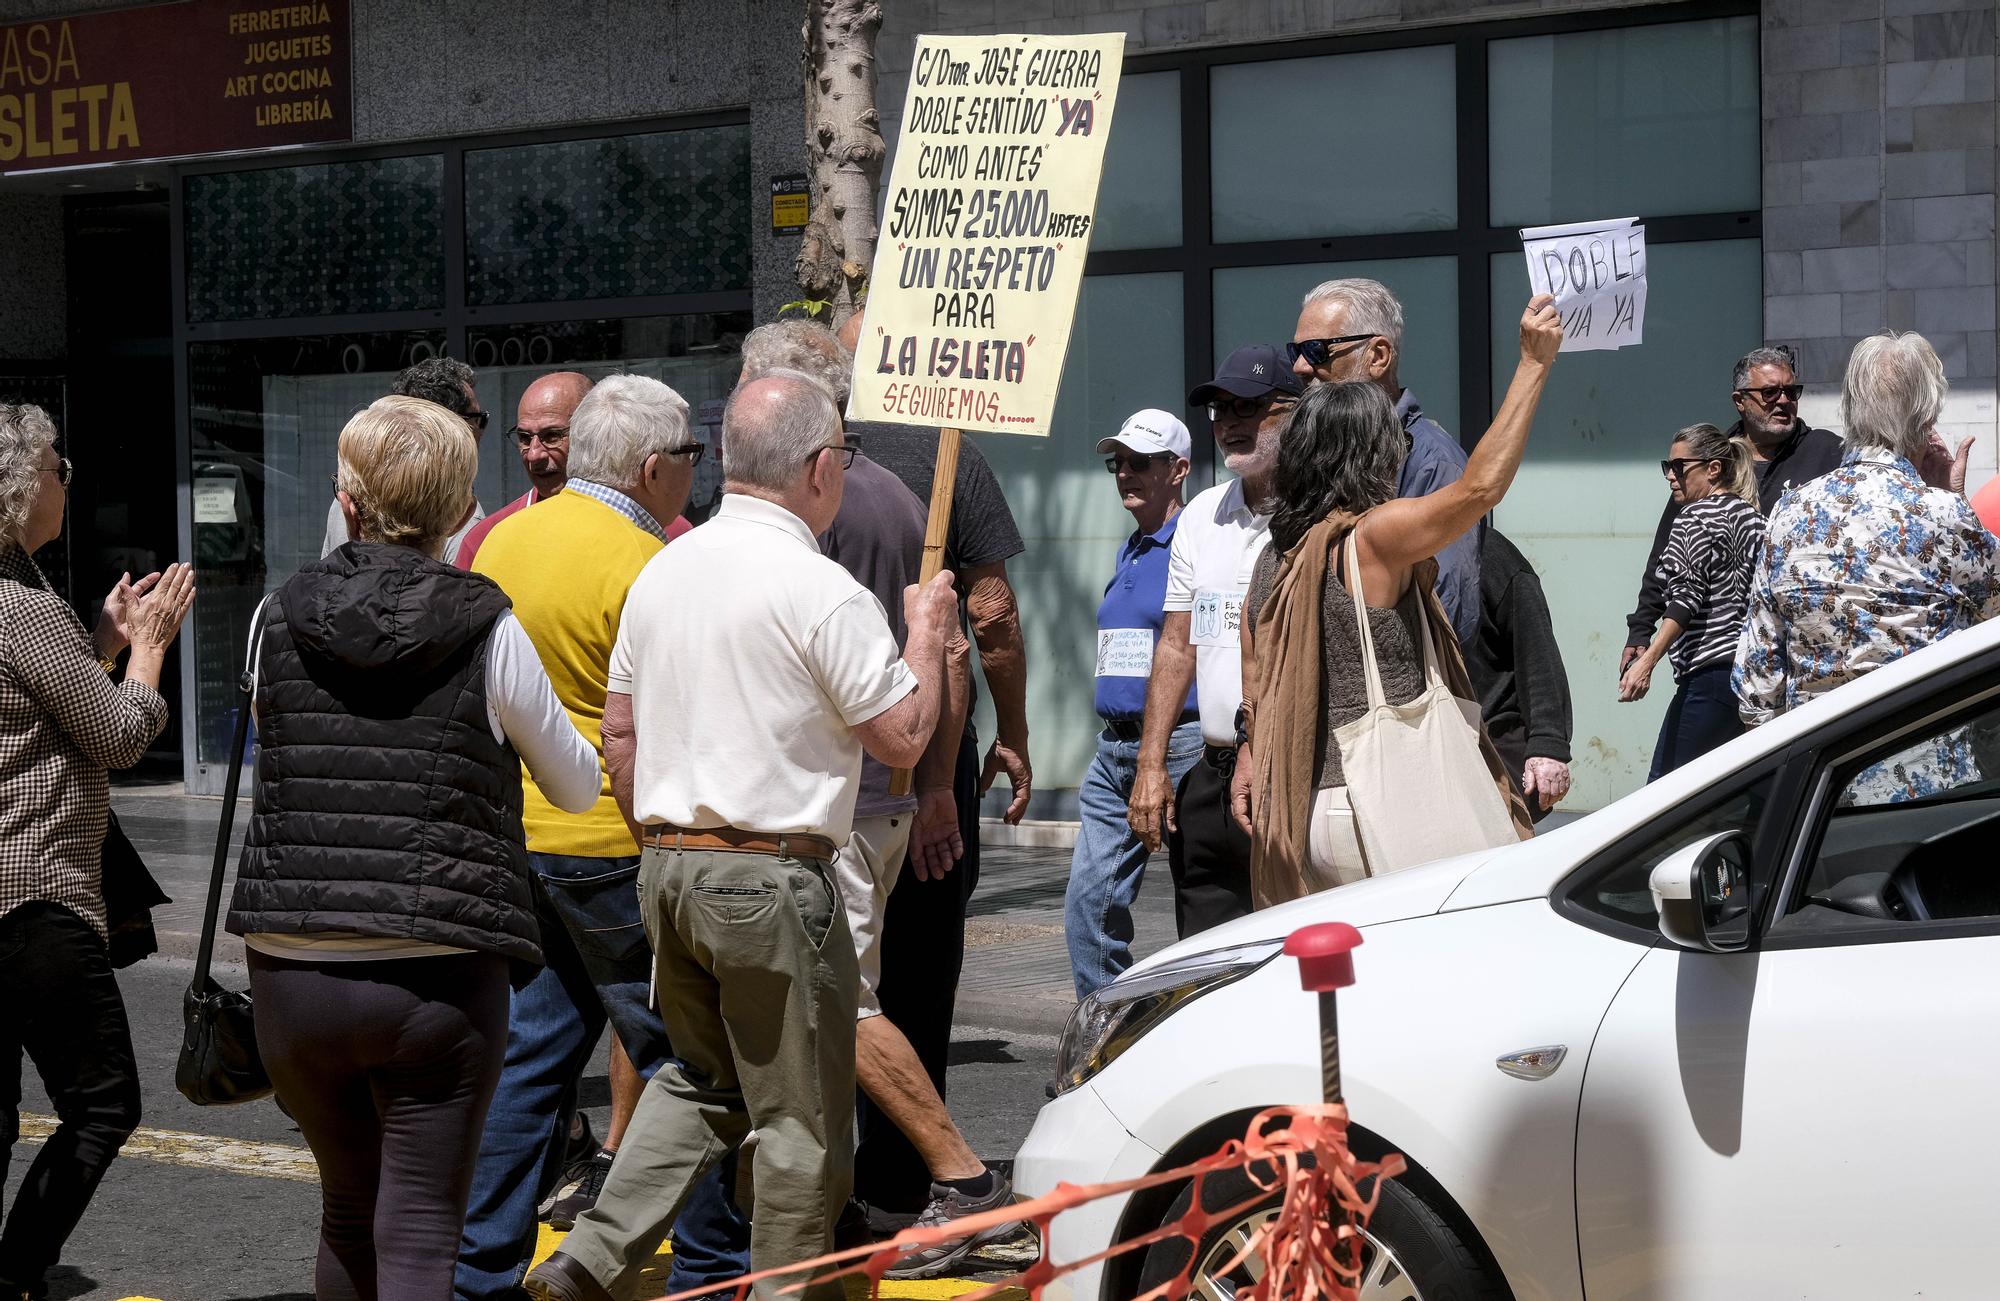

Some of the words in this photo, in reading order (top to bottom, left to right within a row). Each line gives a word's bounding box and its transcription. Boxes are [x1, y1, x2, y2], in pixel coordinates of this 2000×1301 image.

[229, 0, 331, 34] FERRETERÍA
[244, 34, 332, 64] JUGUETES
[975, 37, 1028, 86] JOSÉ
[1026, 49, 1100, 89] GUERRA
[224, 75, 257, 98] ART
[262, 66, 332, 94] COCINA
[256, 94, 333, 126] LIBRERÍA
[909, 96, 965, 135] DOBLE
[890, 187, 963, 239] SOMOS
[963, 189, 1048, 240] 25.000
[1046, 212, 1090, 238] HBTES
[1542, 231, 1645, 297] DOBLE
[933, 292, 995, 329] PARA
[1607, 291, 1634, 336] YA
[1224, 611, 1240, 620] COM
[1225, 601, 1236, 610] EL
